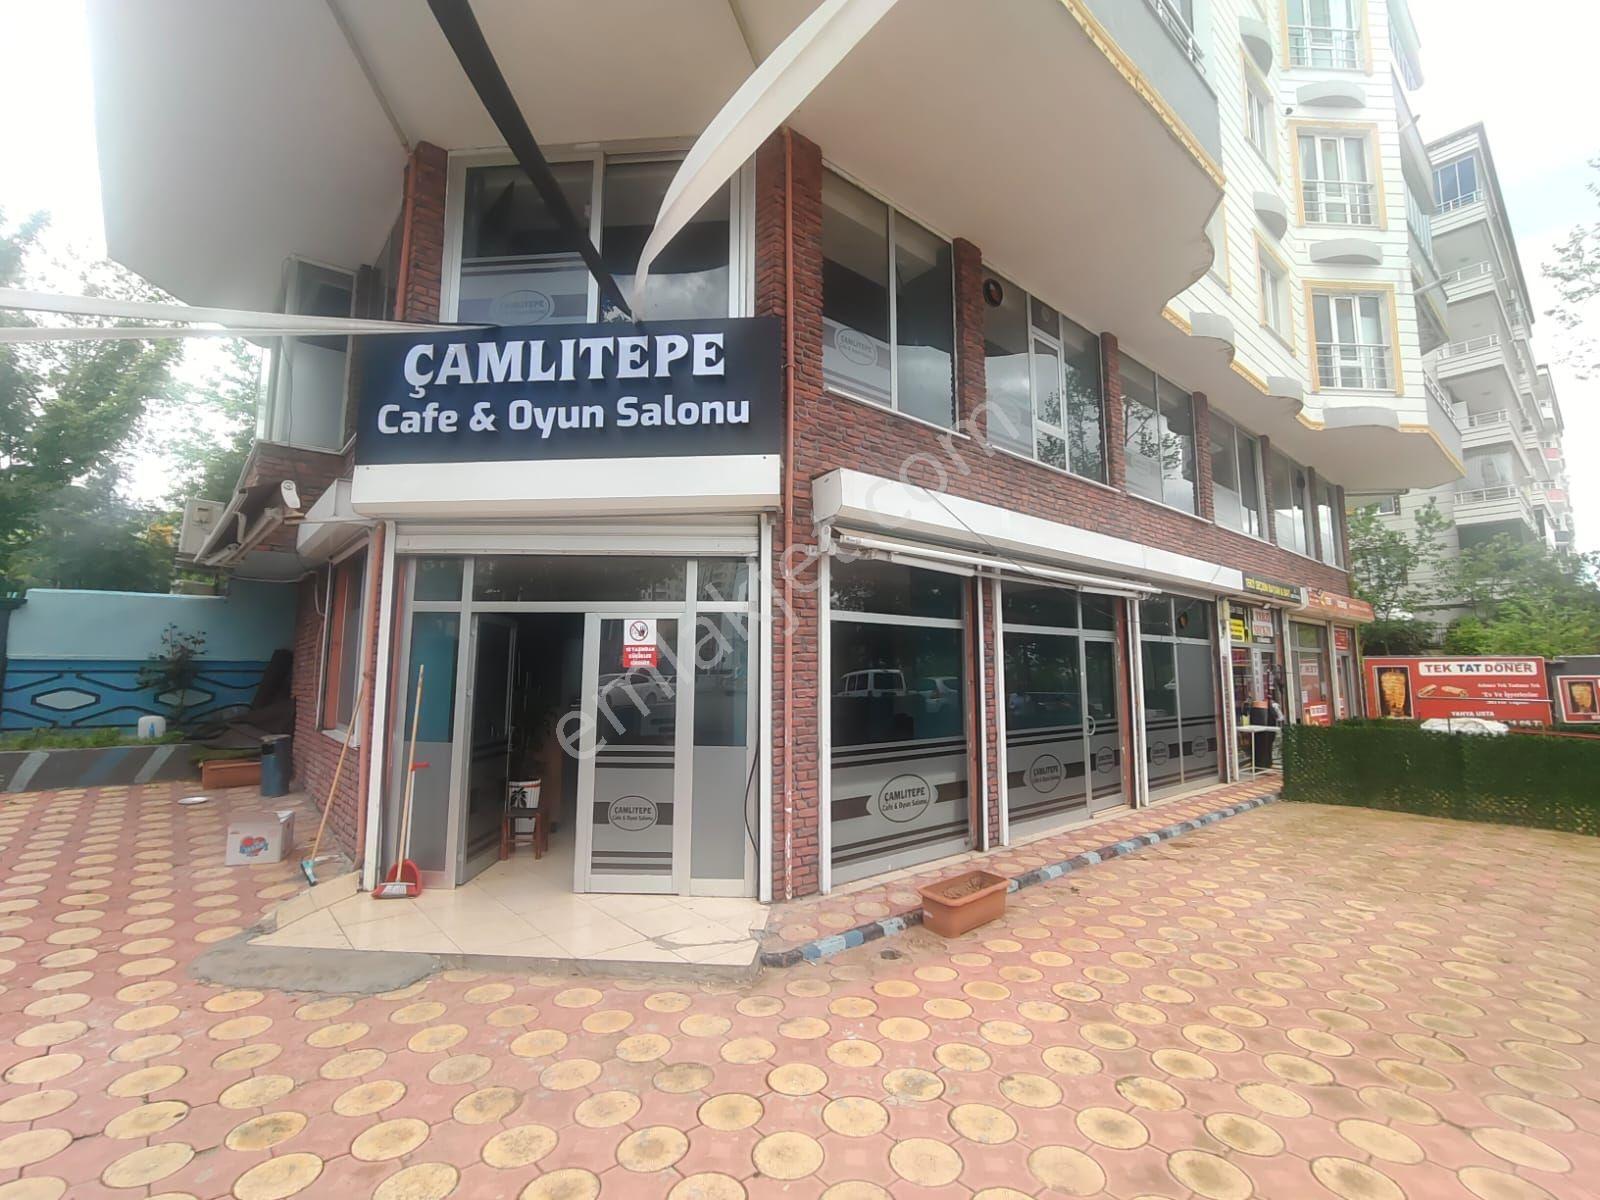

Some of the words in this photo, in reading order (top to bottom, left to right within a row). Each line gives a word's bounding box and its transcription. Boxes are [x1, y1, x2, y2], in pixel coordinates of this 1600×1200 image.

[404, 333, 725, 398] ÇAMLITEPE
[377, 403, 458, 434] Cafe
[469, 401, 498, 432] &
[508, 399, 604, 438] Oyun
[616, 395, 750, 427] Salonu
[1424, 664, 1452, 673] TEK
[1456, 664, 1482, 673] TAT
